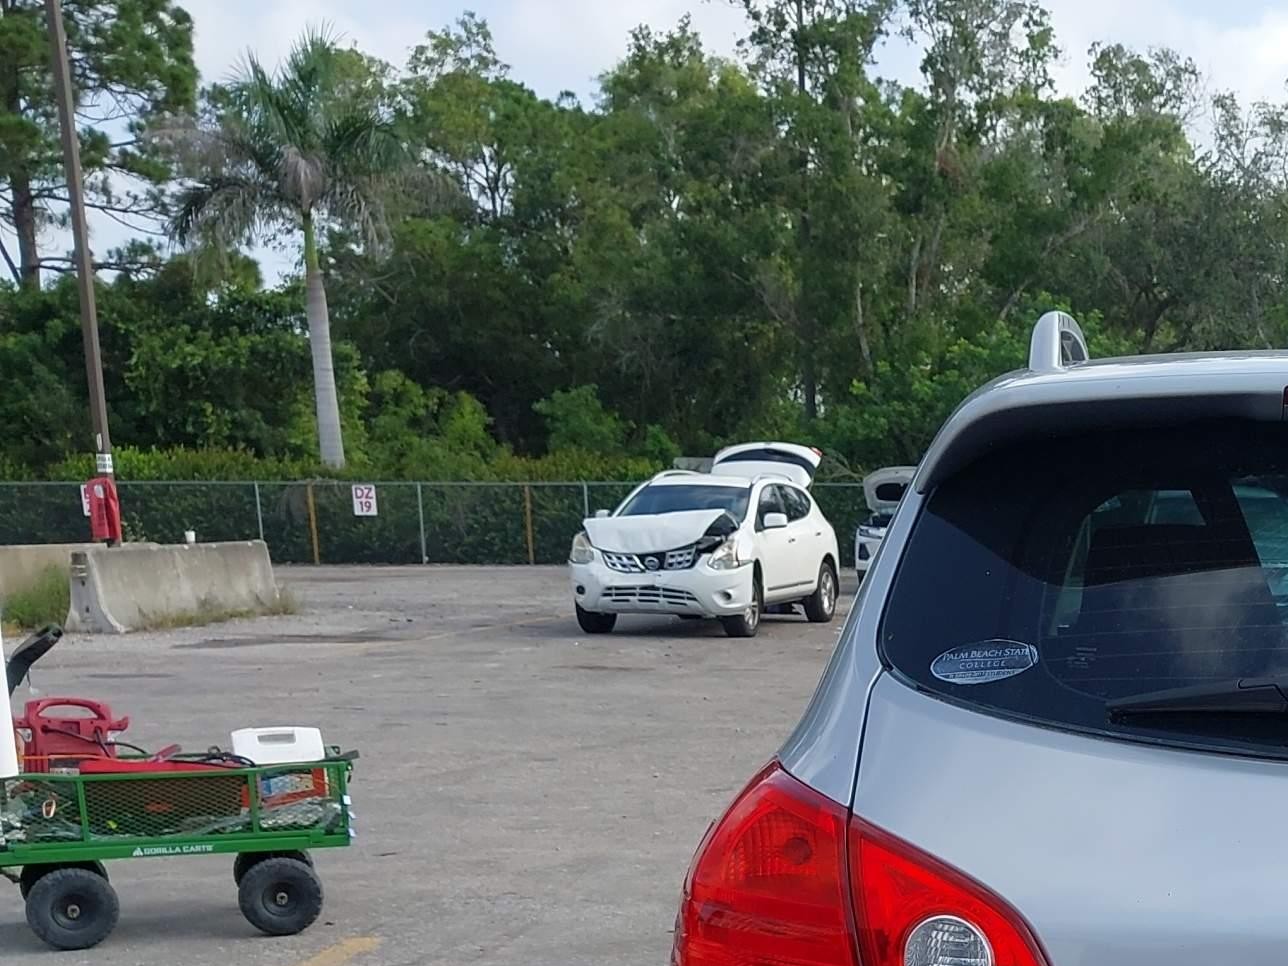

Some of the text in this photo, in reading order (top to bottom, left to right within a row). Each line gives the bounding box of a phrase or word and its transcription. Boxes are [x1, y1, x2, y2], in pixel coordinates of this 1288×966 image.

[354, 486, 374, 499] DZ
[359, 500, 372, 512] 19
[942, 652, 969, 661] PALM
[970, 649, 1003, 658] BEACH
[959, 660, 1006, 670] COLLEGE
[143, 845, 182, 856] GORILLA
